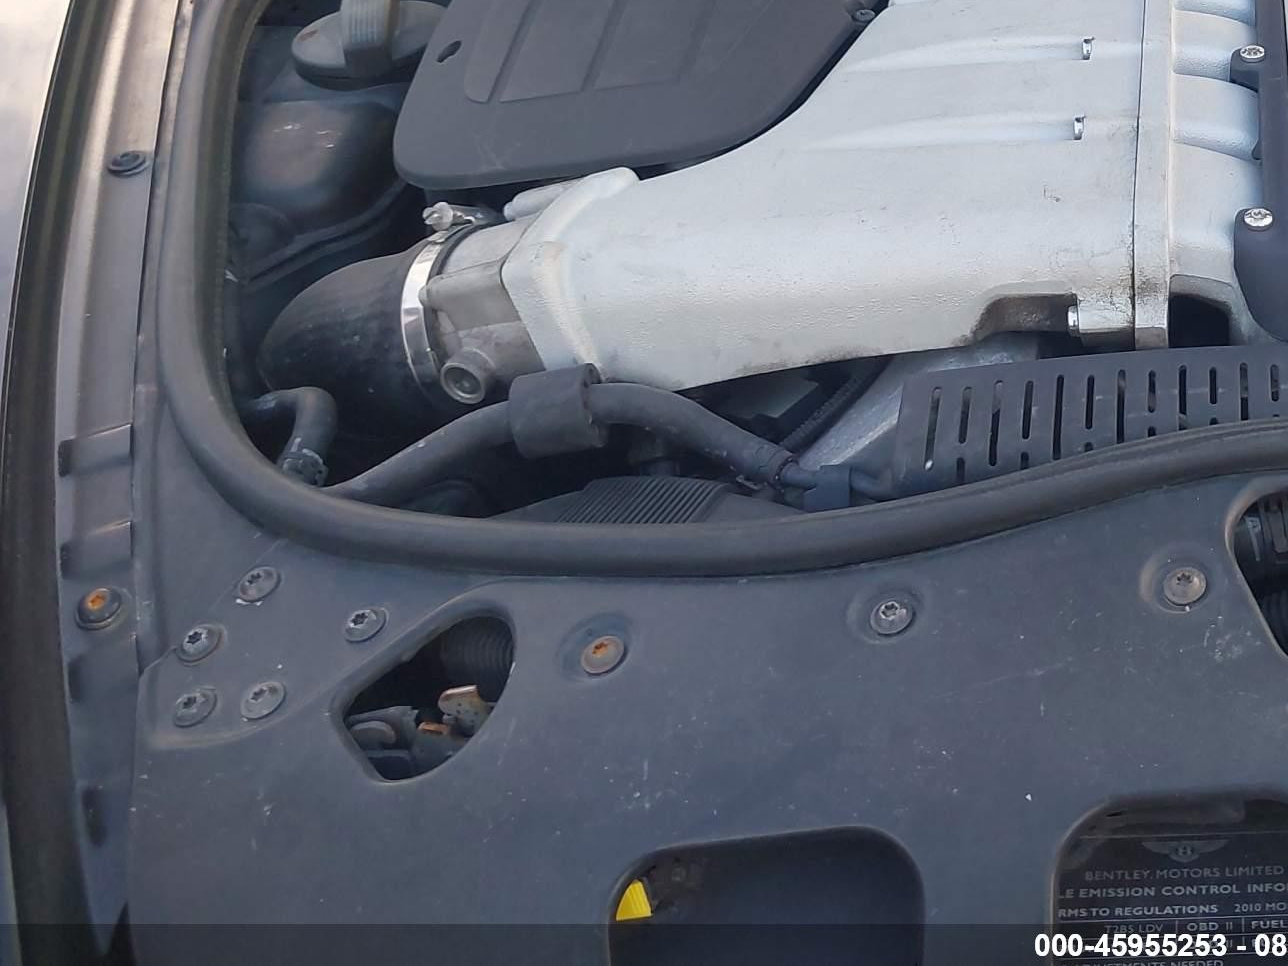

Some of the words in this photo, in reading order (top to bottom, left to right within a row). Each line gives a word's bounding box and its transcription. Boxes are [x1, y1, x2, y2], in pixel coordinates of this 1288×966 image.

[1085, 870, 1149, 881] BENTLEY
[1156, 868, 1220, 879] MOTORS
[1226, 866, 1284, 877] LIMITED
[1079, 887, 1156, 898] EMISSION
[1161, 884, 1240, 896] CONTROL
[1090, 908, 1110, 916] TO
[1115, 904, 1218, 916] REGULATIONS
[1234, 903, 1262, 913] 2010
[1138, 924, 1164, 933] LDV
[1186, 922, 1219, 931] OBD
[1251, 920, 1288, 929] FUEL
